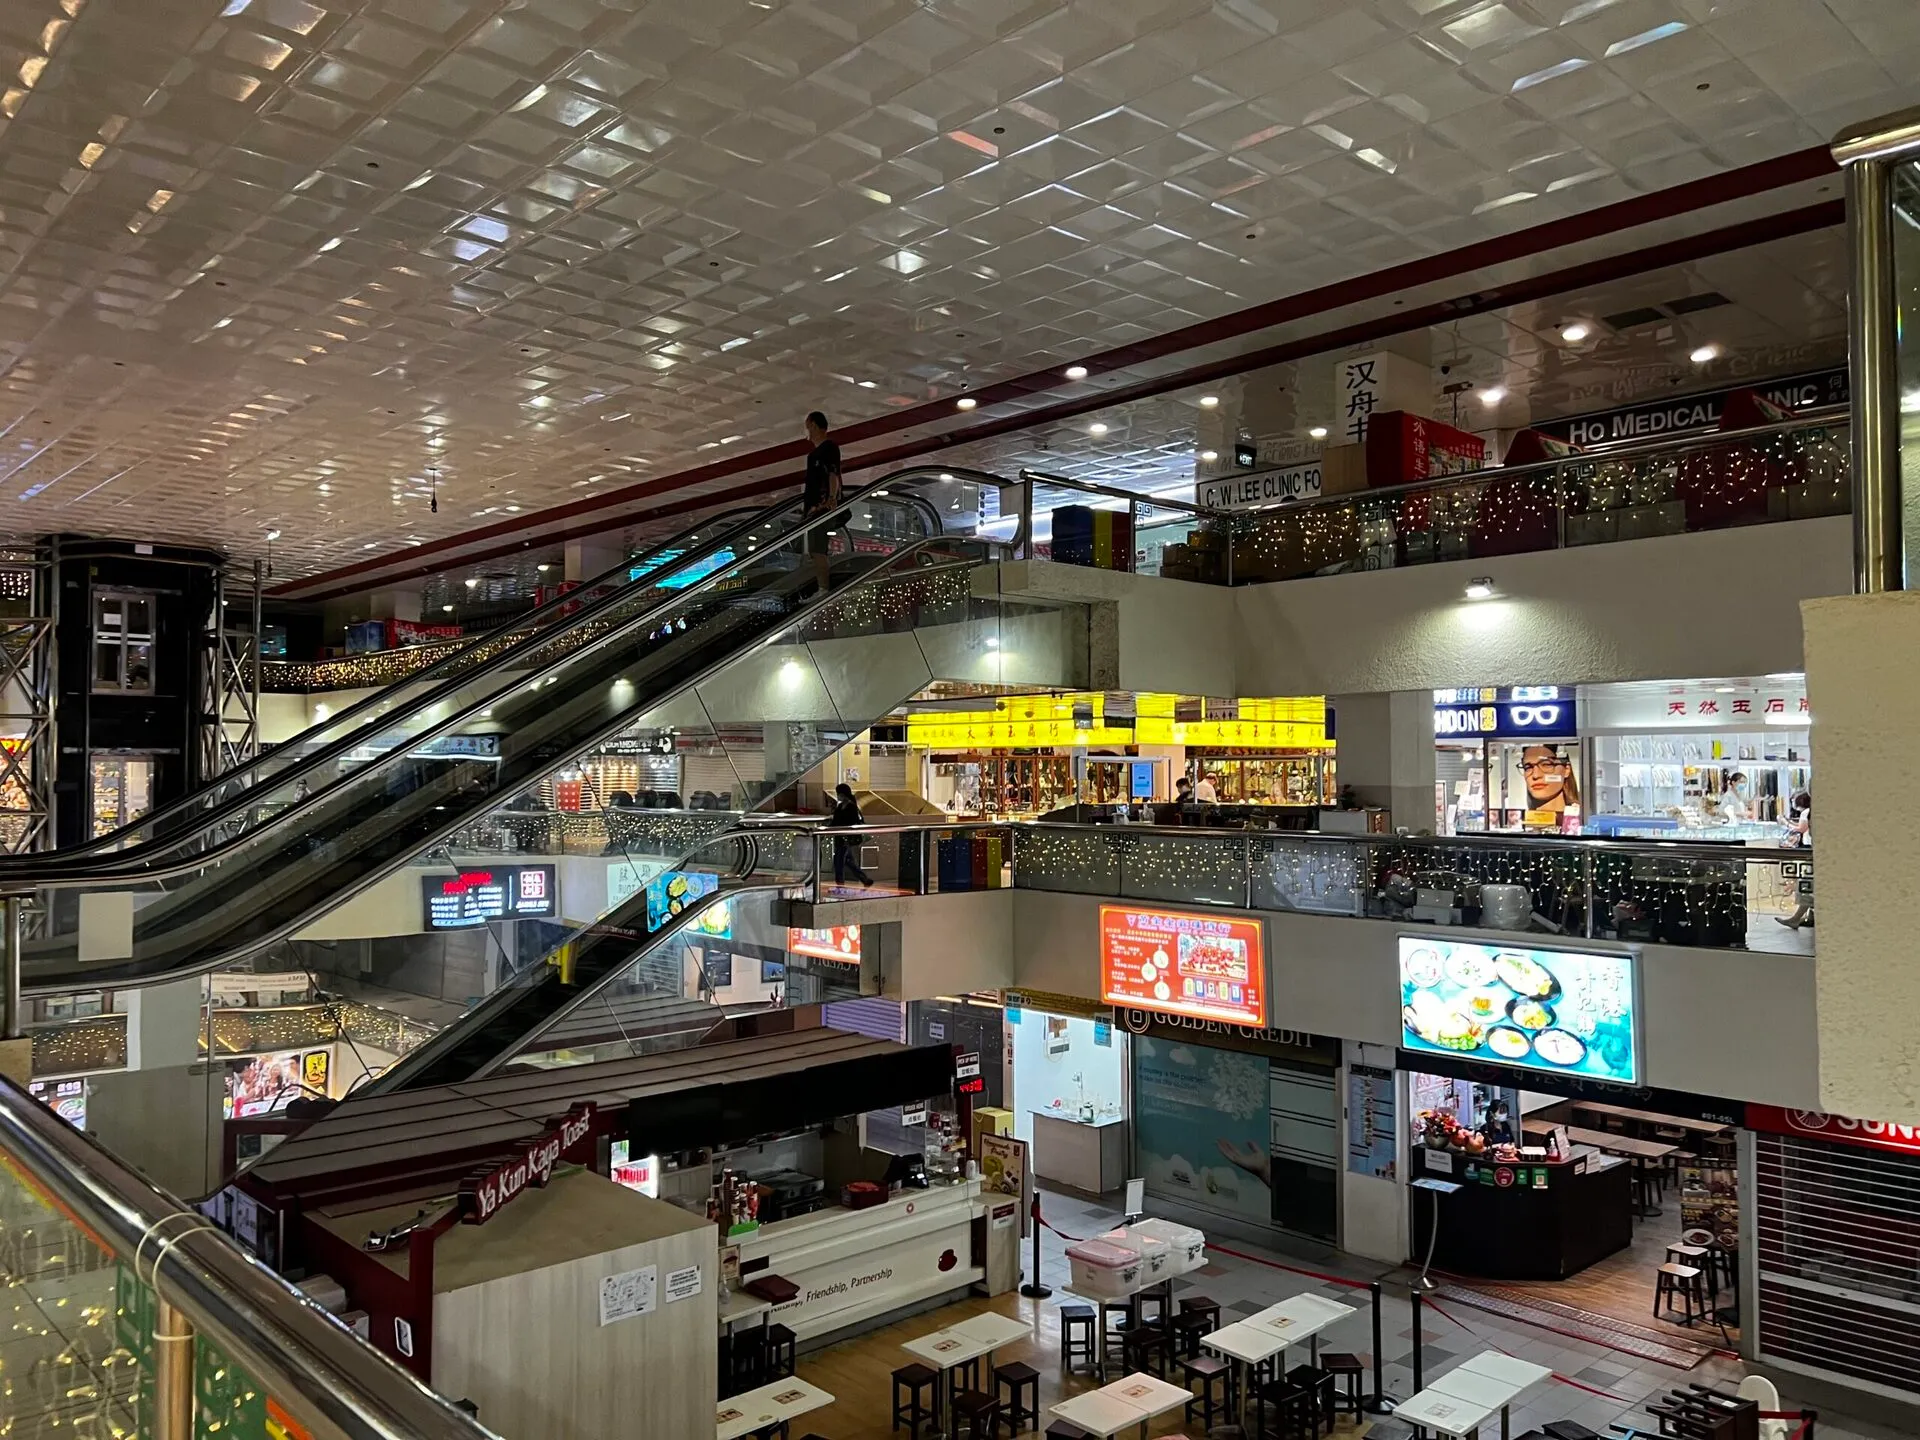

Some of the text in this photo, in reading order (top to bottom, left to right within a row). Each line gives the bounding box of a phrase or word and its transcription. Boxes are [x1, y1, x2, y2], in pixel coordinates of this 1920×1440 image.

[1612, 403, 1721, 438] MEDICAL
[1263, 470, 1301, 499] CLINIC
[478, 1107, 590, 1217] Ya Kun Kaya Toast
[806, 1267, 893, 1303] Friendship, Partnership
